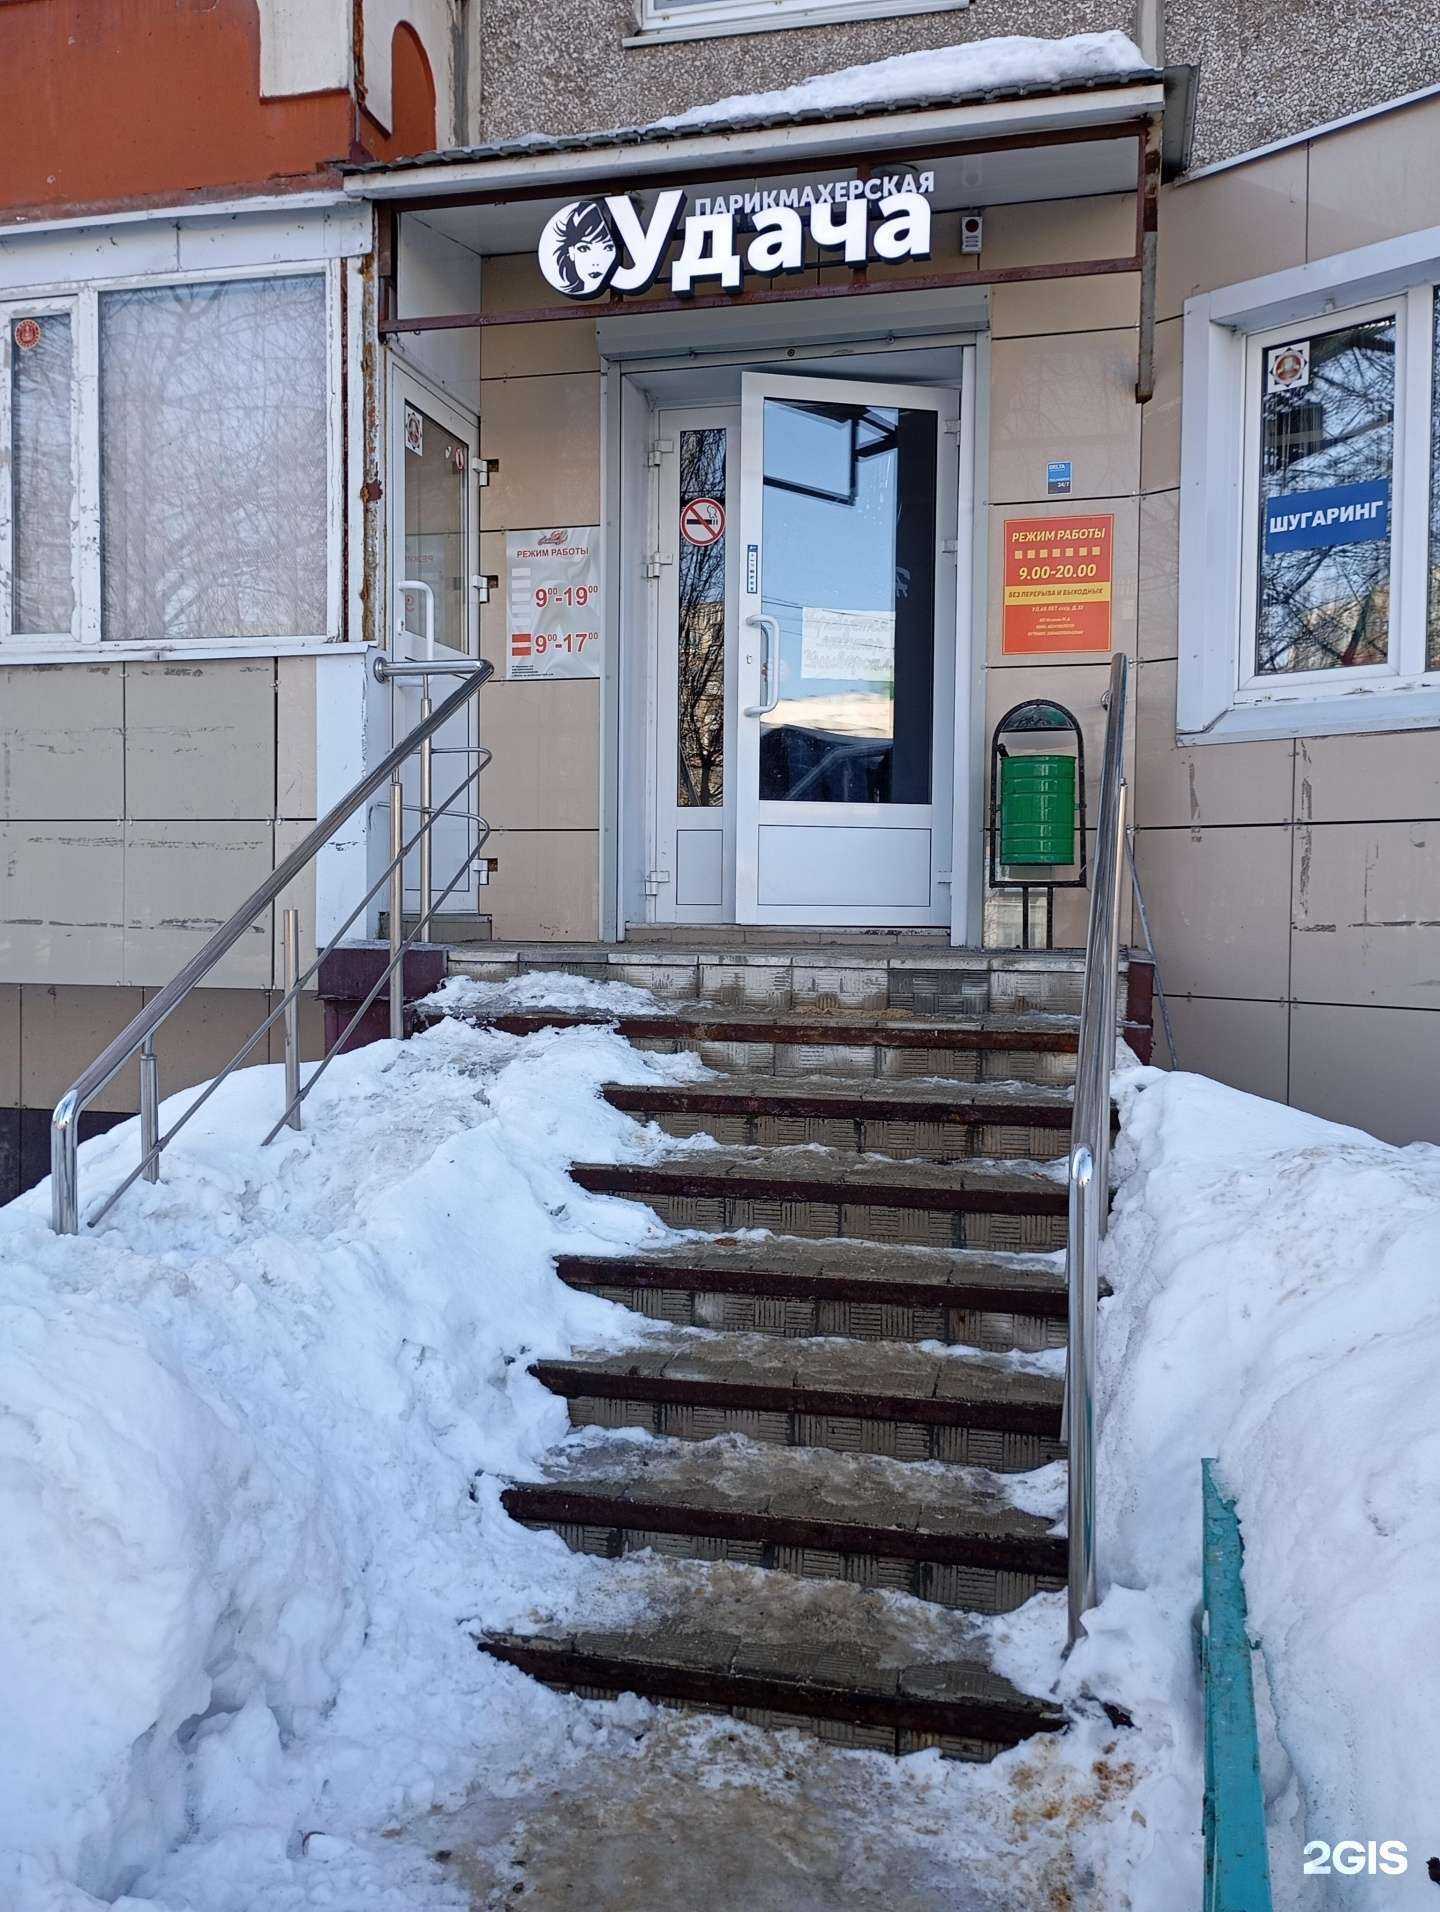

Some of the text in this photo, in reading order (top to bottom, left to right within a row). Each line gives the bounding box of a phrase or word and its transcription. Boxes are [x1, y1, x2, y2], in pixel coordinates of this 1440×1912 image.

[695, 171, 934, 216] ПАРИКМАХЕРСКАЯ
[605, 190, 931, 292] Удача
[1269, 501, 1384, 534] ШУГАРИНГ
[1012, 528, 1105, 542] РЕЖИМ РАБОТЫ
[516, 547, 589, 558] РЕЖИМ РАБОТЫ
